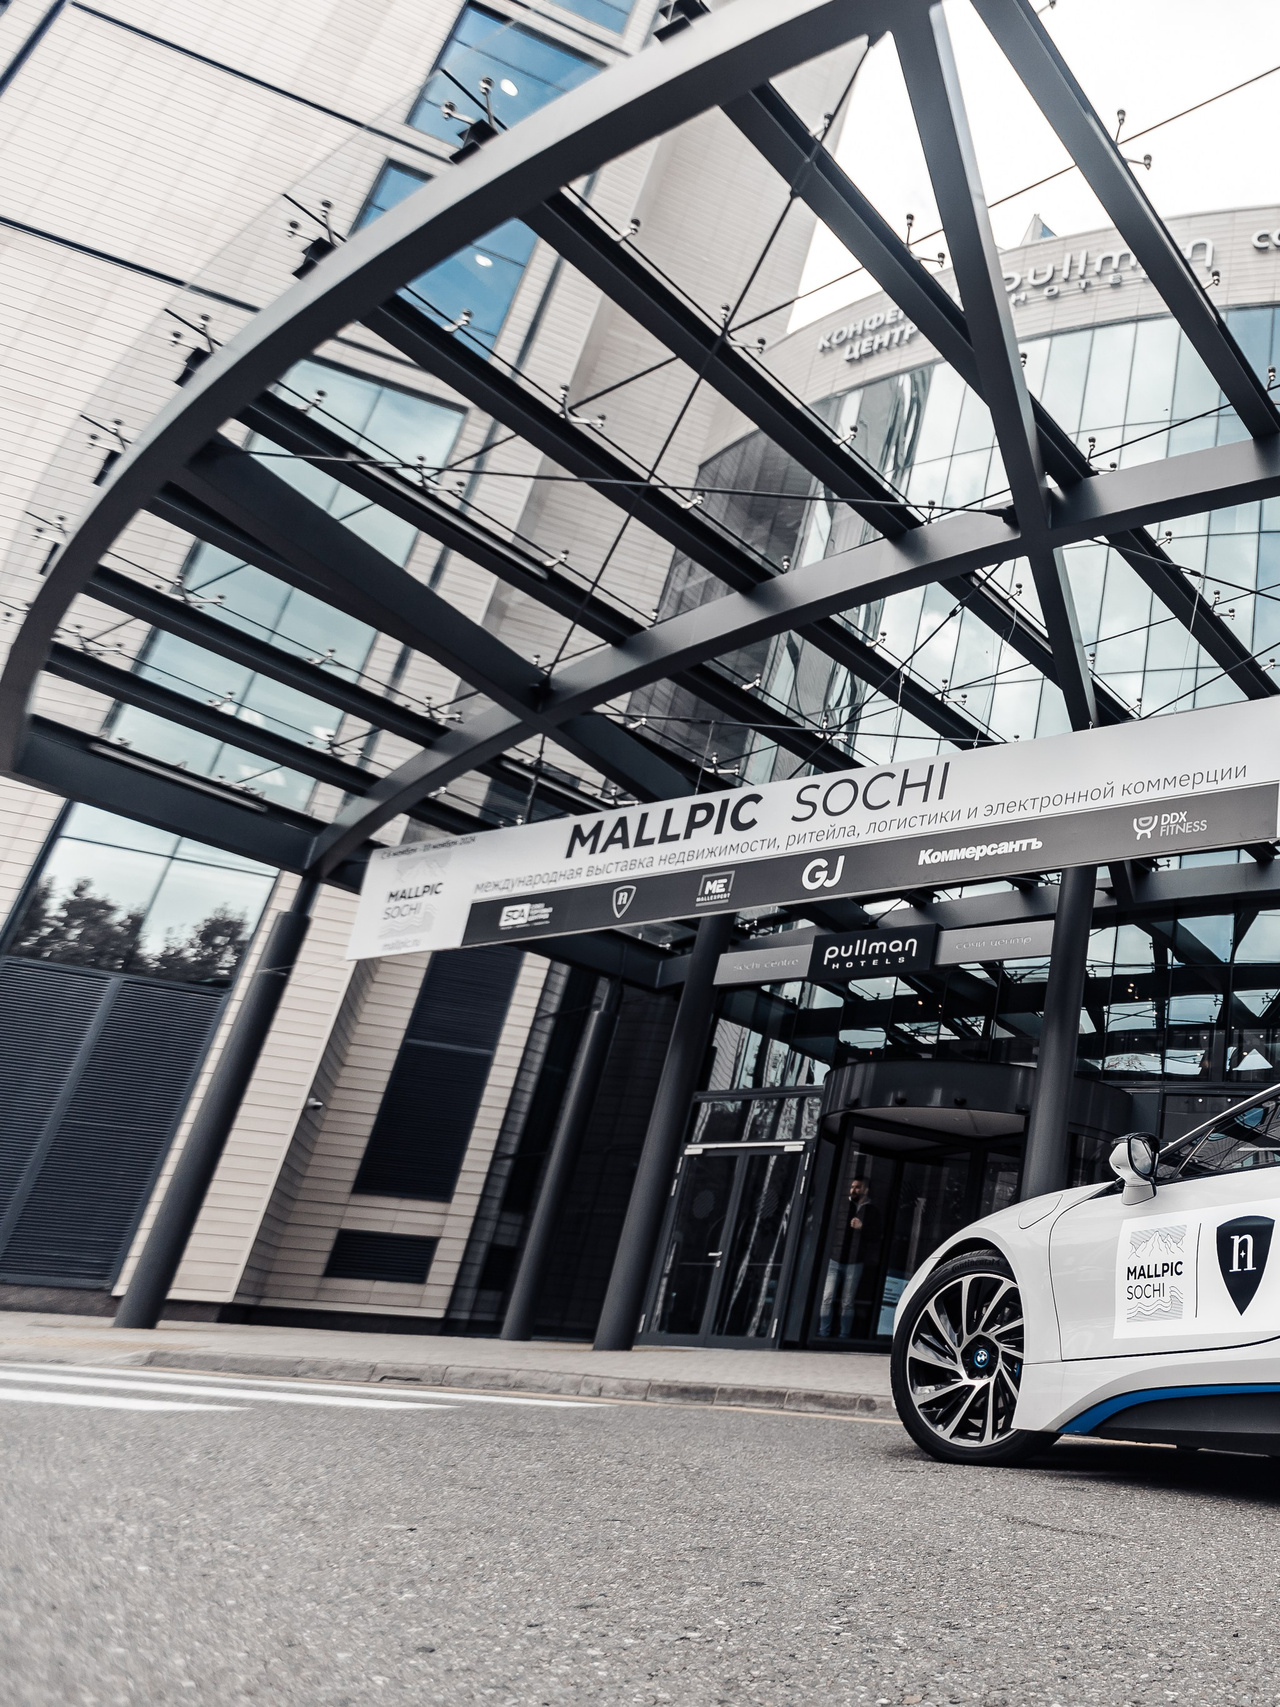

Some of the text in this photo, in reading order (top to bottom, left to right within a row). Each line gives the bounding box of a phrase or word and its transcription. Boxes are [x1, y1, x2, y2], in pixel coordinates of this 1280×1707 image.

[843, 323, 918, 361] ЦЕНТР
[565, 762, 951, 859] MALLPIC SOCHI
[1160, 811, 1188, 826] DDX
[474, 764, 1248, 895] международная выставка недвижимости, ритейла, логистики и электронной коммерции
[1160, 819, 1208, 837] FITNESS
[917, 837, 1043, 866] Коммерсантъ
[801, 855, 846, 890] GJ
[387, 882, 444, 903] MALLPIC
[704, 878, 728, 895] ME
[382, 902, 423, 920] SOCHI
[823, 938, 918, 965] pullman
[832, 956, 906, 969] HOTELS
[1126, 1261, 1184, 1281] MALLPIC
[1126, 1283, 1165, 1300] SOCHI
